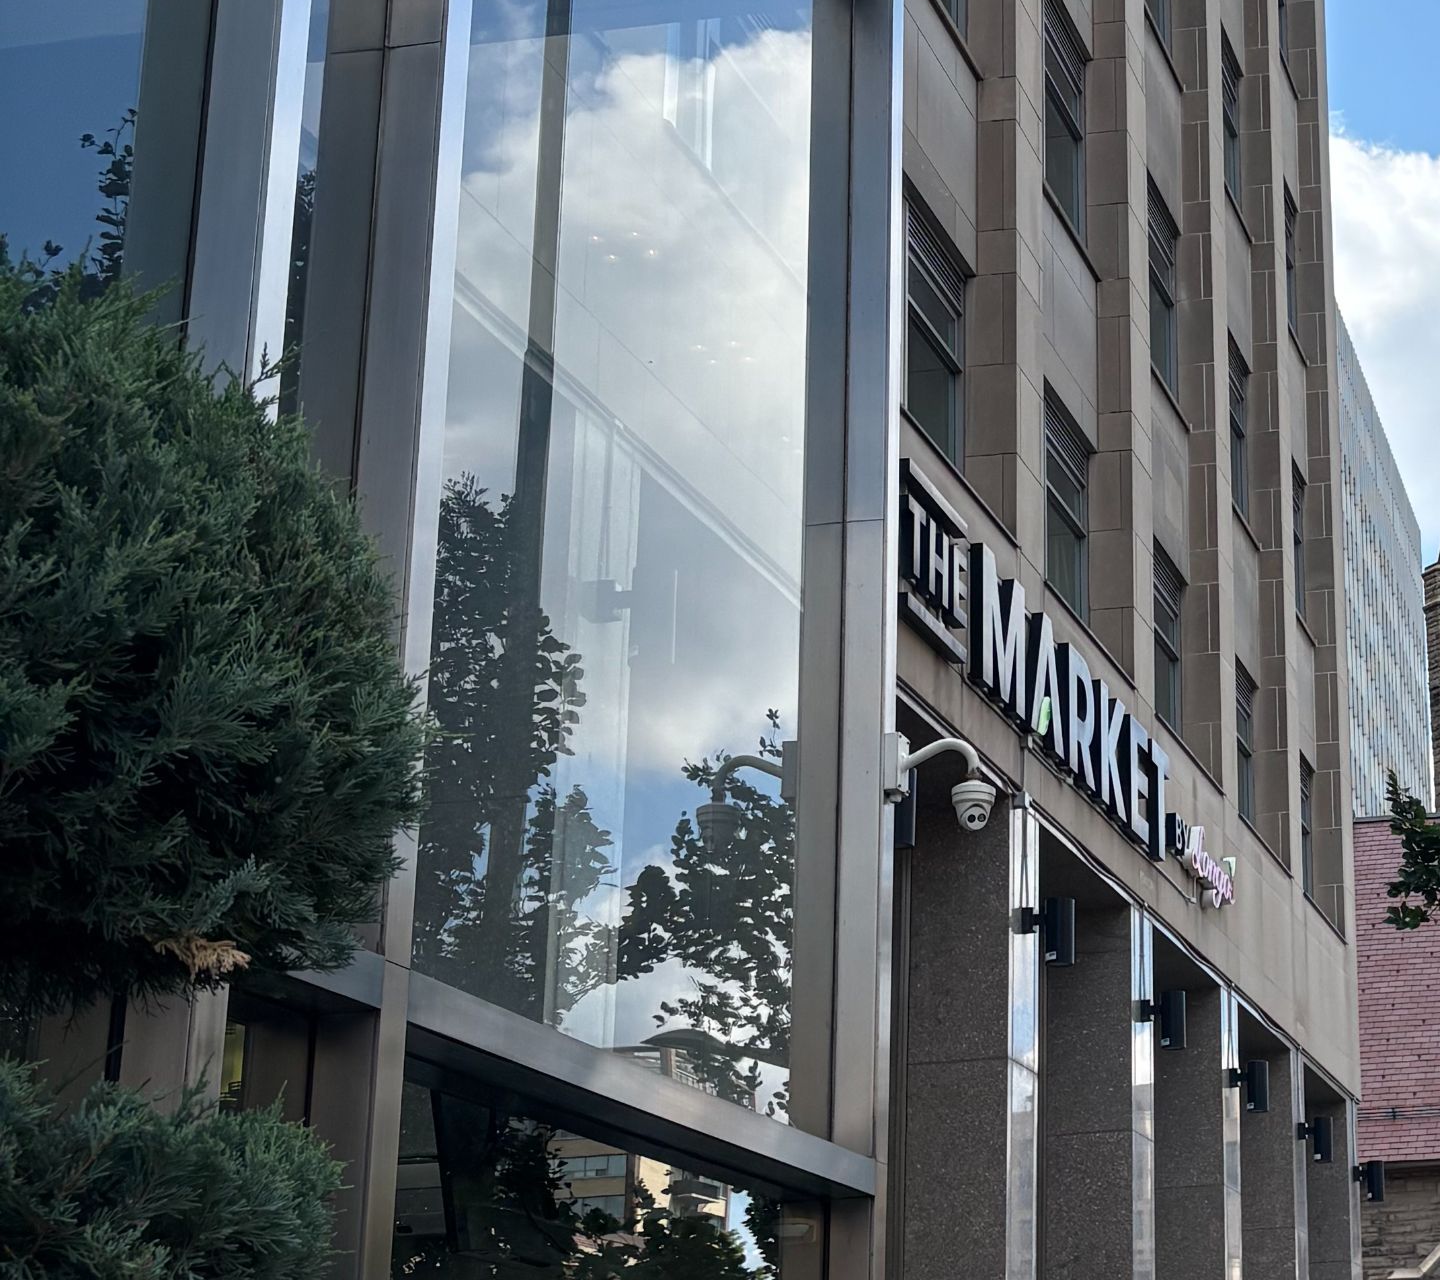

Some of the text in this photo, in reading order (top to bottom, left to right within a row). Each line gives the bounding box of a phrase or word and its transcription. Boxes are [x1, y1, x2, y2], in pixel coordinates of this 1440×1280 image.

[908, 502, 1170, 862] THE MARKET
[1175, 813, 1191, 853] BY
